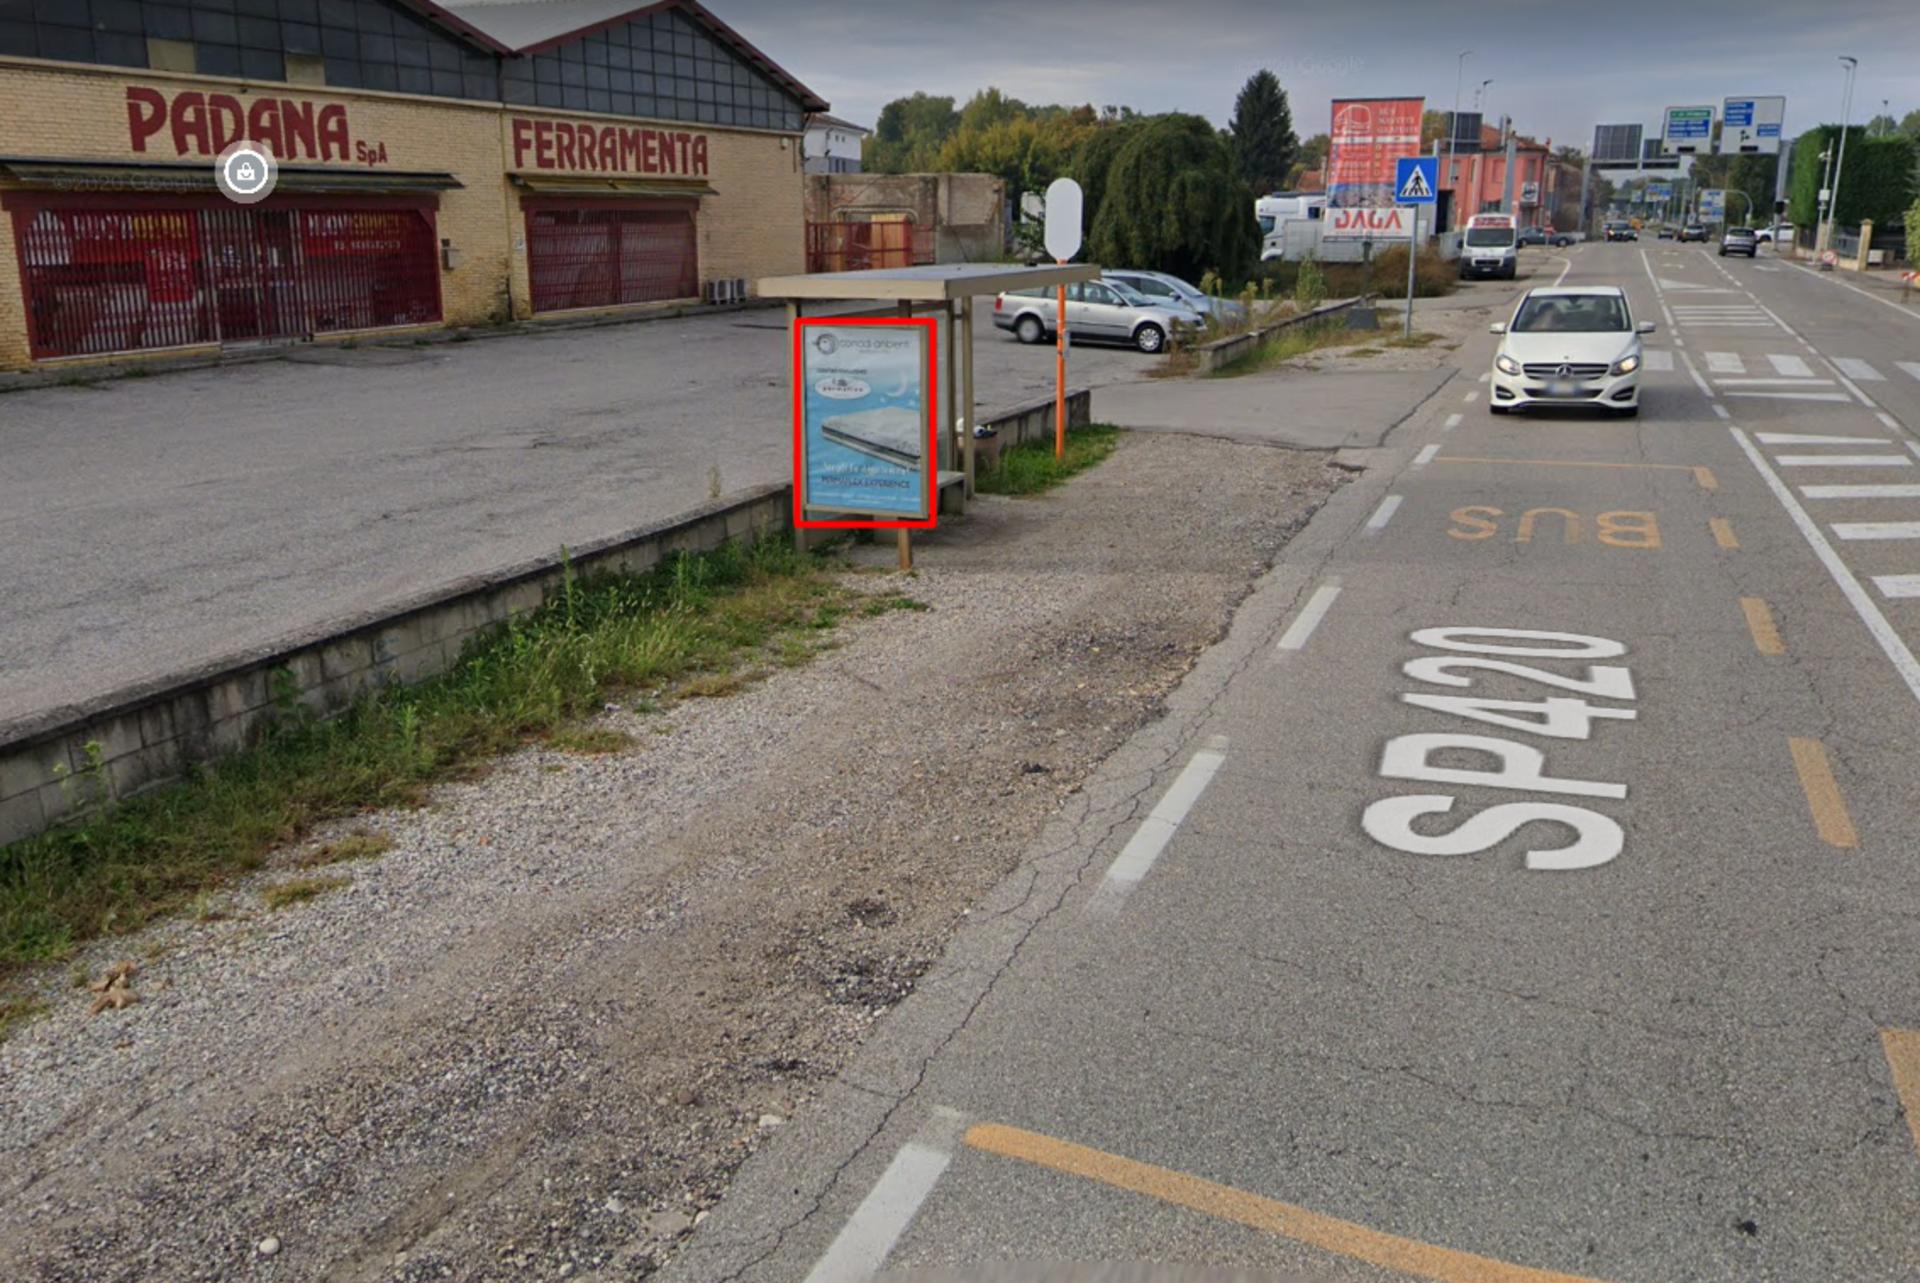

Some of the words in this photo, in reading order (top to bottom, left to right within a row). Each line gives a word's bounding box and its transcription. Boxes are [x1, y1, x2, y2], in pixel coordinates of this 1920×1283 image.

[125, 86, 350, 162] PADANA
[356, 140, 388, 167] SpA
[512, 118, 709, 176] FERRAMENTA
[1446, 505, 1663, 549] BUS
[1361, 626, 1637, 870] SP420
